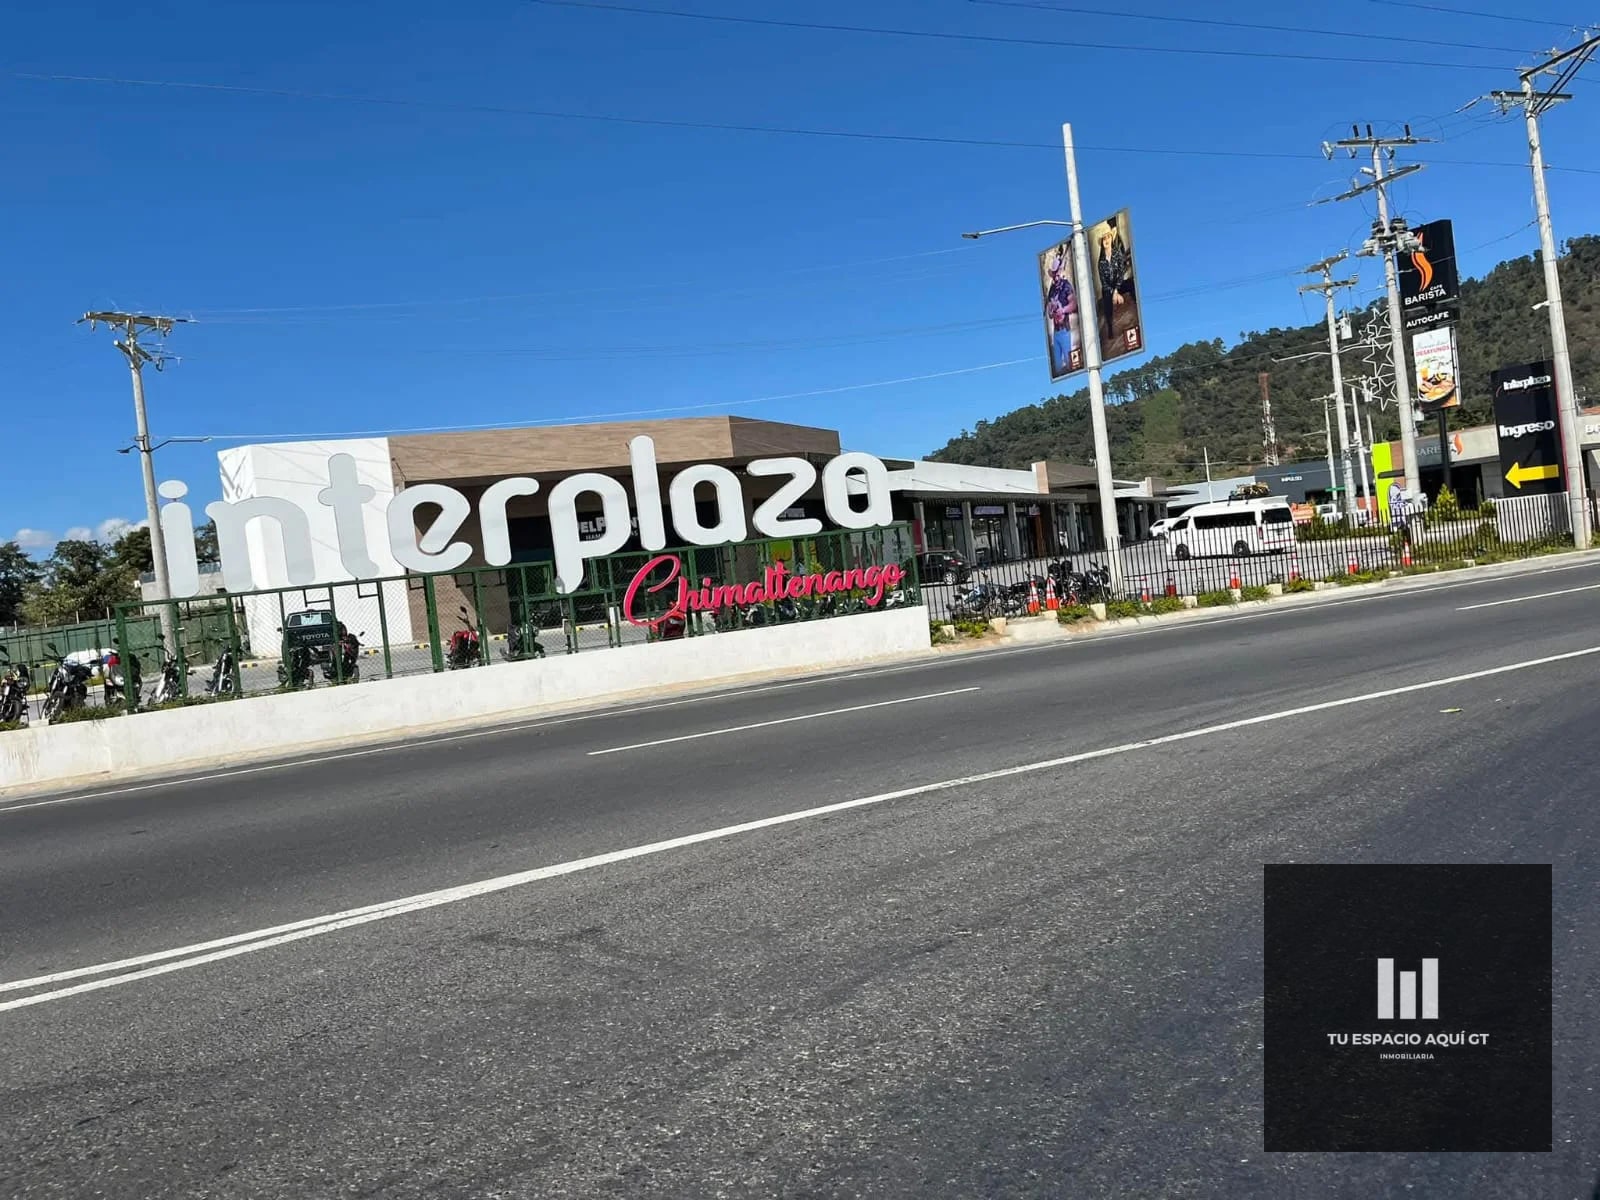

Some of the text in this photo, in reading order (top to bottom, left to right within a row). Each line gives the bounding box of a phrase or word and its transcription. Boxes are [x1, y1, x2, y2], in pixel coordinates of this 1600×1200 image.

[1404, 288, 1447, 306] BARISTA
[1406, 311, 1449, 328] AUTOCAFE
[1499, 420, 1555, 438] Ingreso
[158, 435, 893, 598] interplaza
[623, 554, 907, 627] Chimaltenango
[301, 632, 330, 641] TOYOTA
